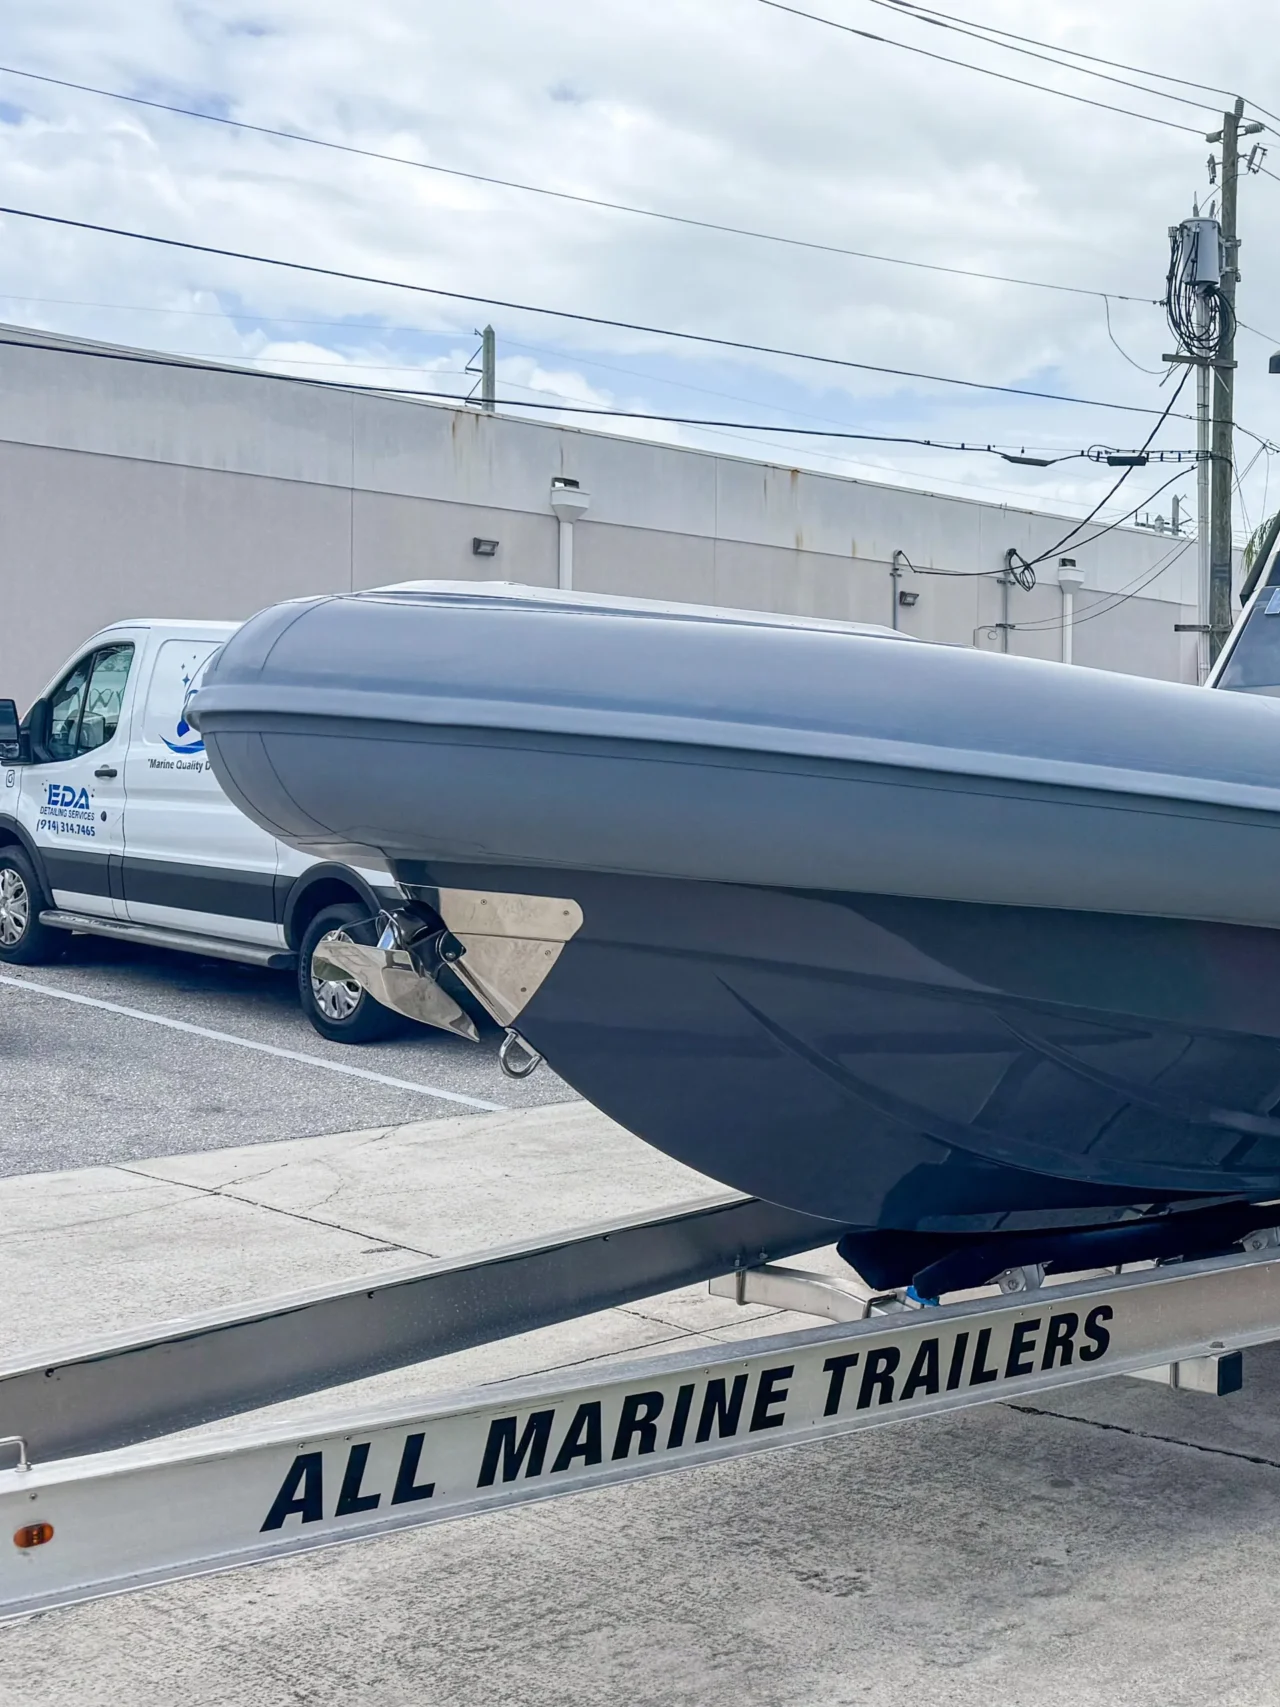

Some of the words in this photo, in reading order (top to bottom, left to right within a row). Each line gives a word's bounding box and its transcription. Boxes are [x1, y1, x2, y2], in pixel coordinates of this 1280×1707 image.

[176, 760, 203, 773] Quality
[47, 784, 90, 810] EDA
[40, 806, 67, 817] DETAILING
[68, 810, 95, 821] SERVICES
[36, 819, 59, 834] (914)
[60, 822, 96, 836] 314.7465
[260, 1433, 435, 1533] ALL
[477, 1365, 794, 1488] MARINE
[822, 1304, 1113, 1416] TRAILERS
